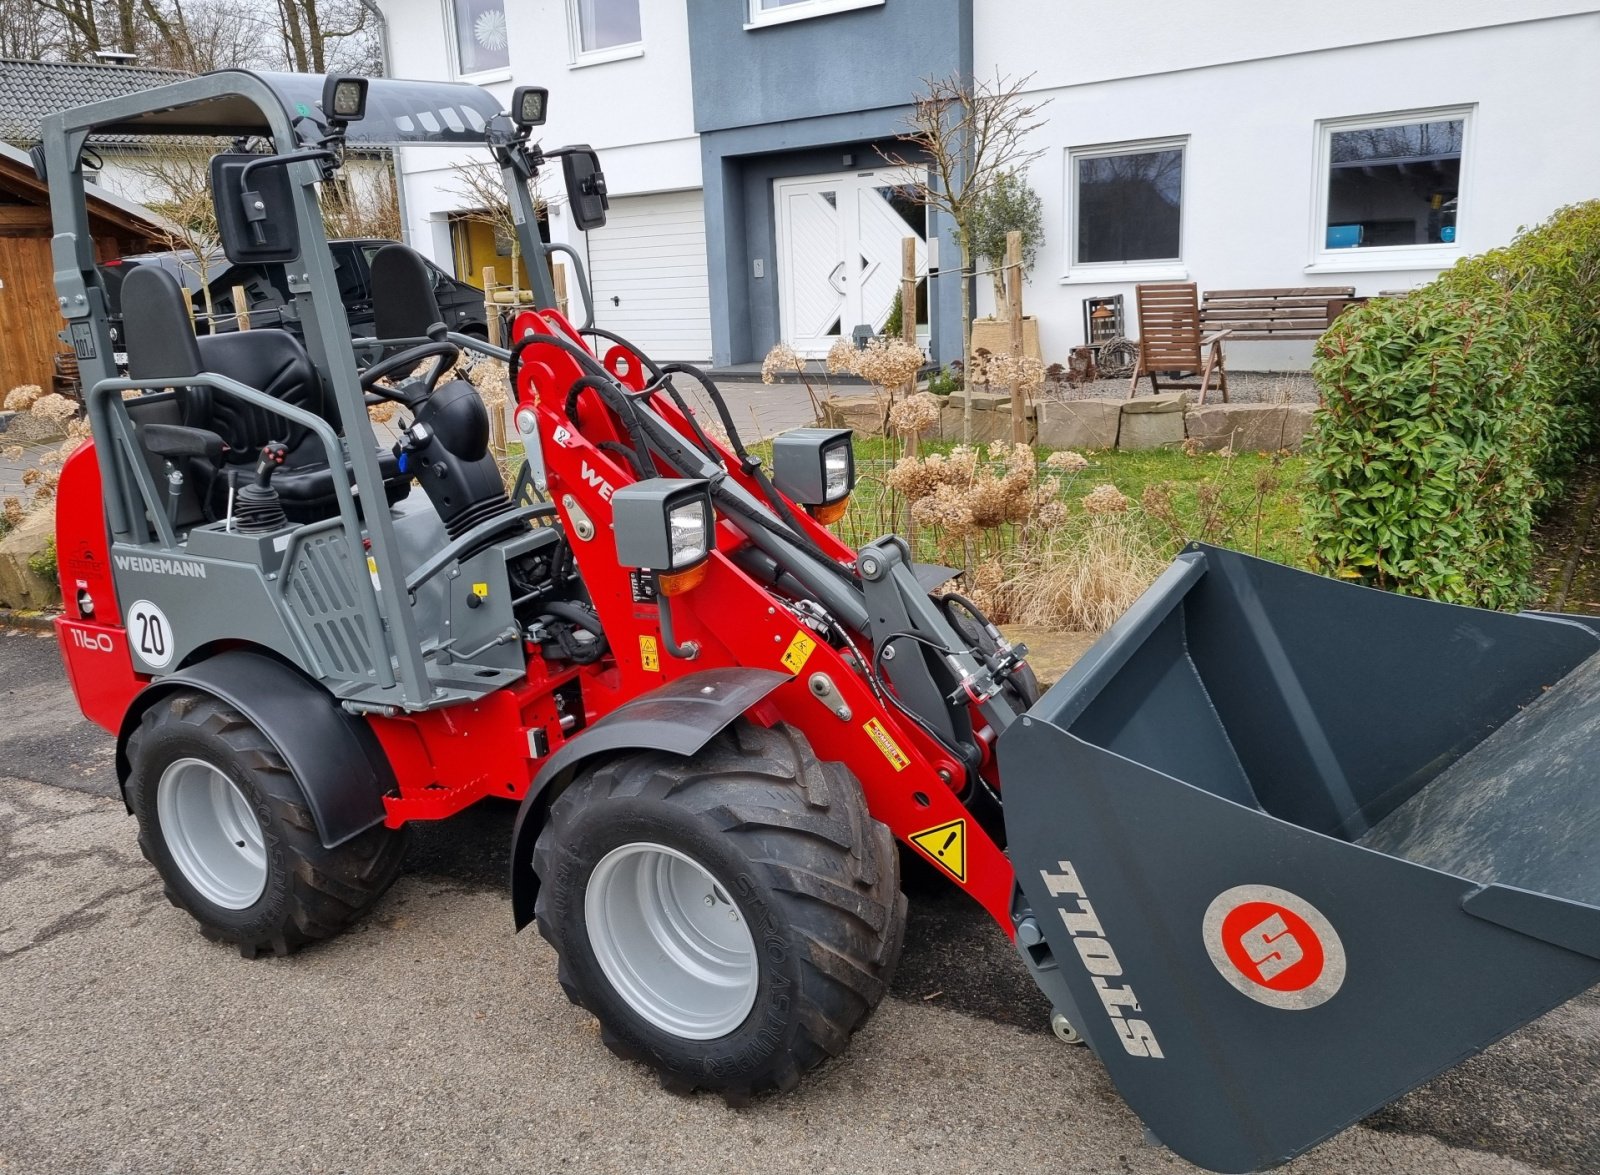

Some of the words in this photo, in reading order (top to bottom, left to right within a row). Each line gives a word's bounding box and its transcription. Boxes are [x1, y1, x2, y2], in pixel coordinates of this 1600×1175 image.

[581, 459, 614, 506] WE
[113, 555, 207, 579] WEIDEMANN
[70, 628, 114, 653] 1160
[136, 612, 165, 656] 20
[873, 726, 898, 757] SOMMER
[735, 872, 790, 964] STARCO
[770, 968, 791, 1013] AS
[1039, 860, 1165, 1059] STOLL
[1239, 912, 1304, 982] S
